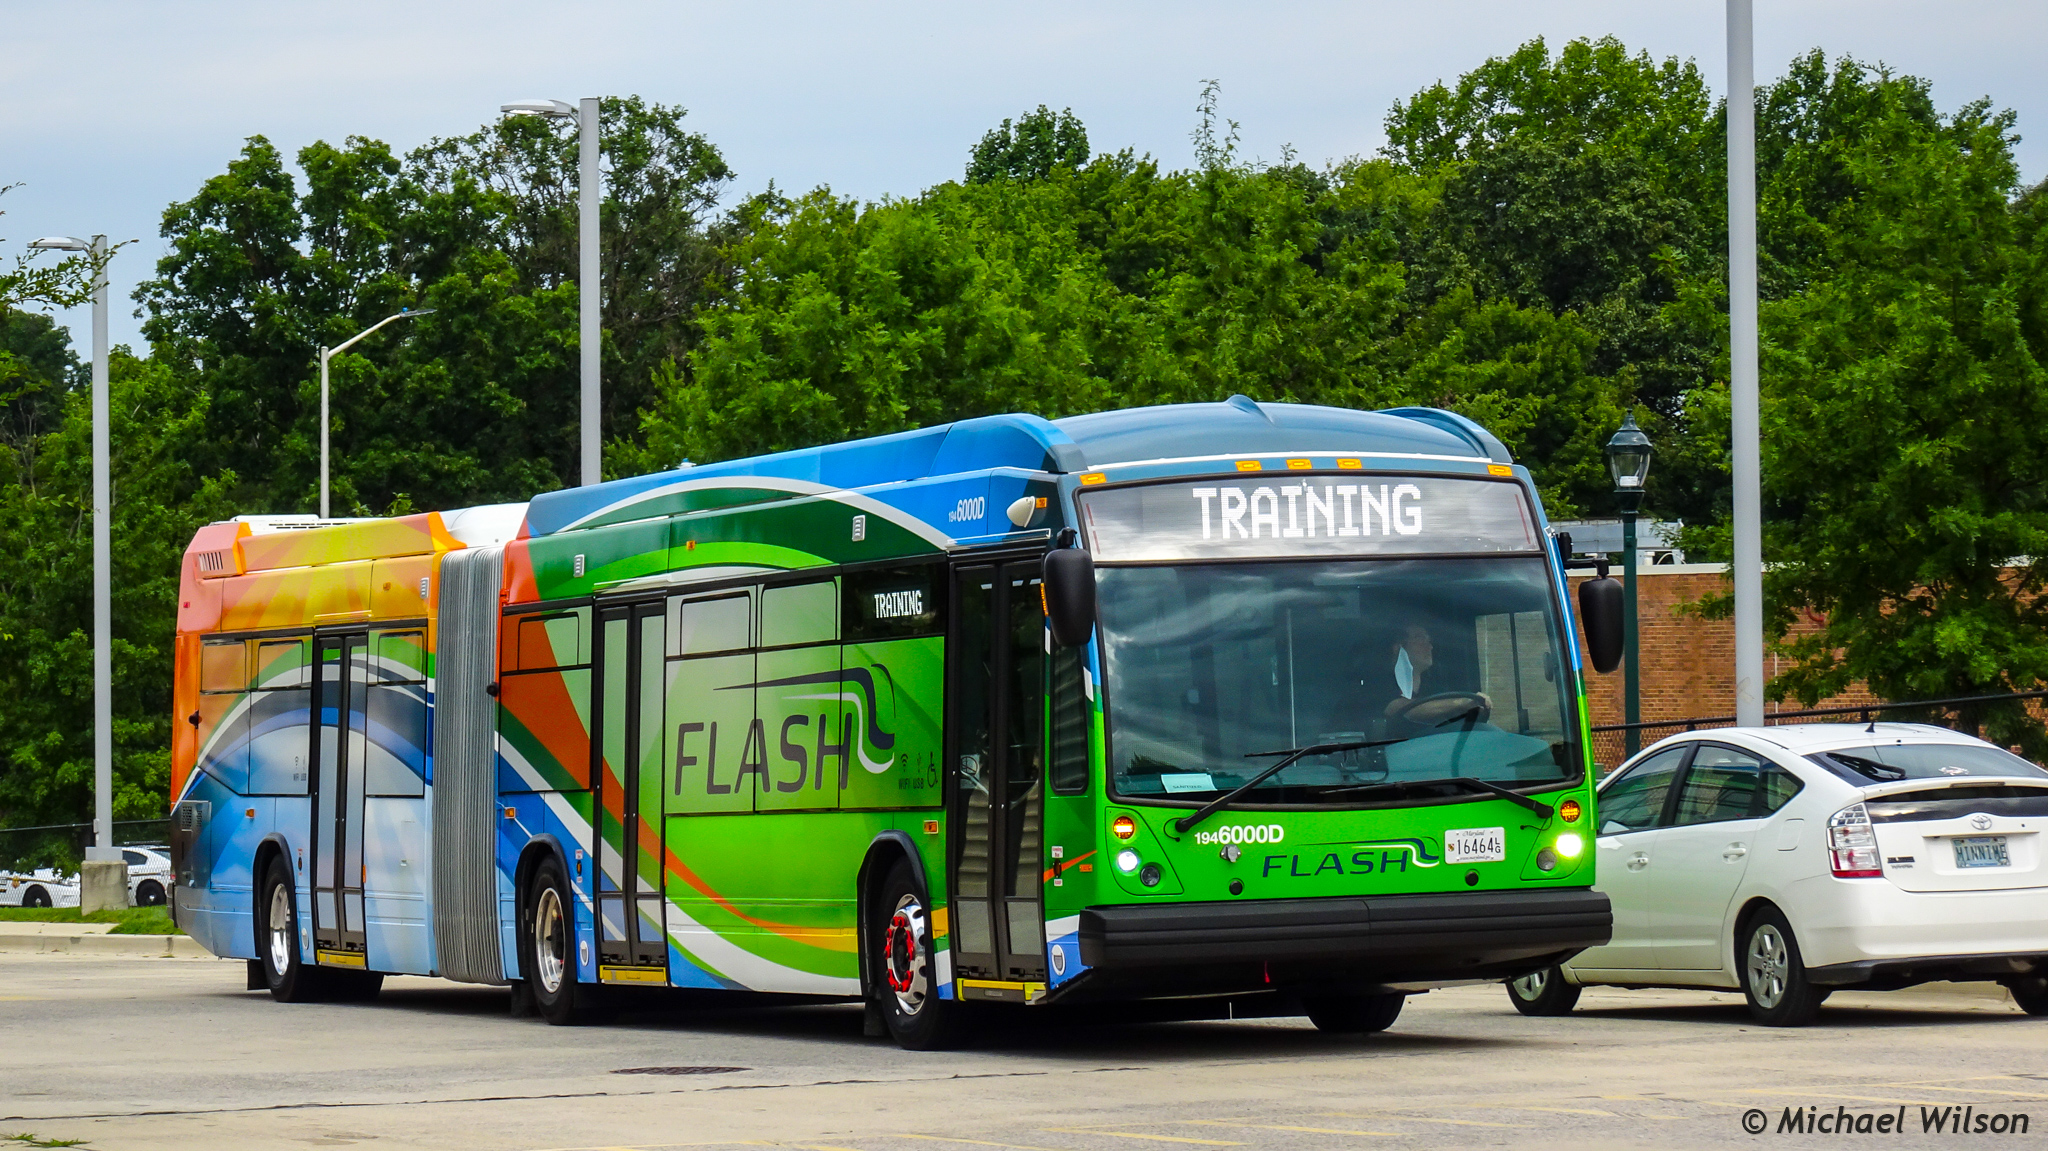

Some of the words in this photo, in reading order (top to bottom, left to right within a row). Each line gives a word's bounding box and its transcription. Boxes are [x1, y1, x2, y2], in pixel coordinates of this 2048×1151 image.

[1192, 484, 1423, 539] TRAINING
[873, 589, 923, 619] TRAINING
[674, 712, 853, 796] FLASH
[1262, 850, 1408, 878] FLASH
